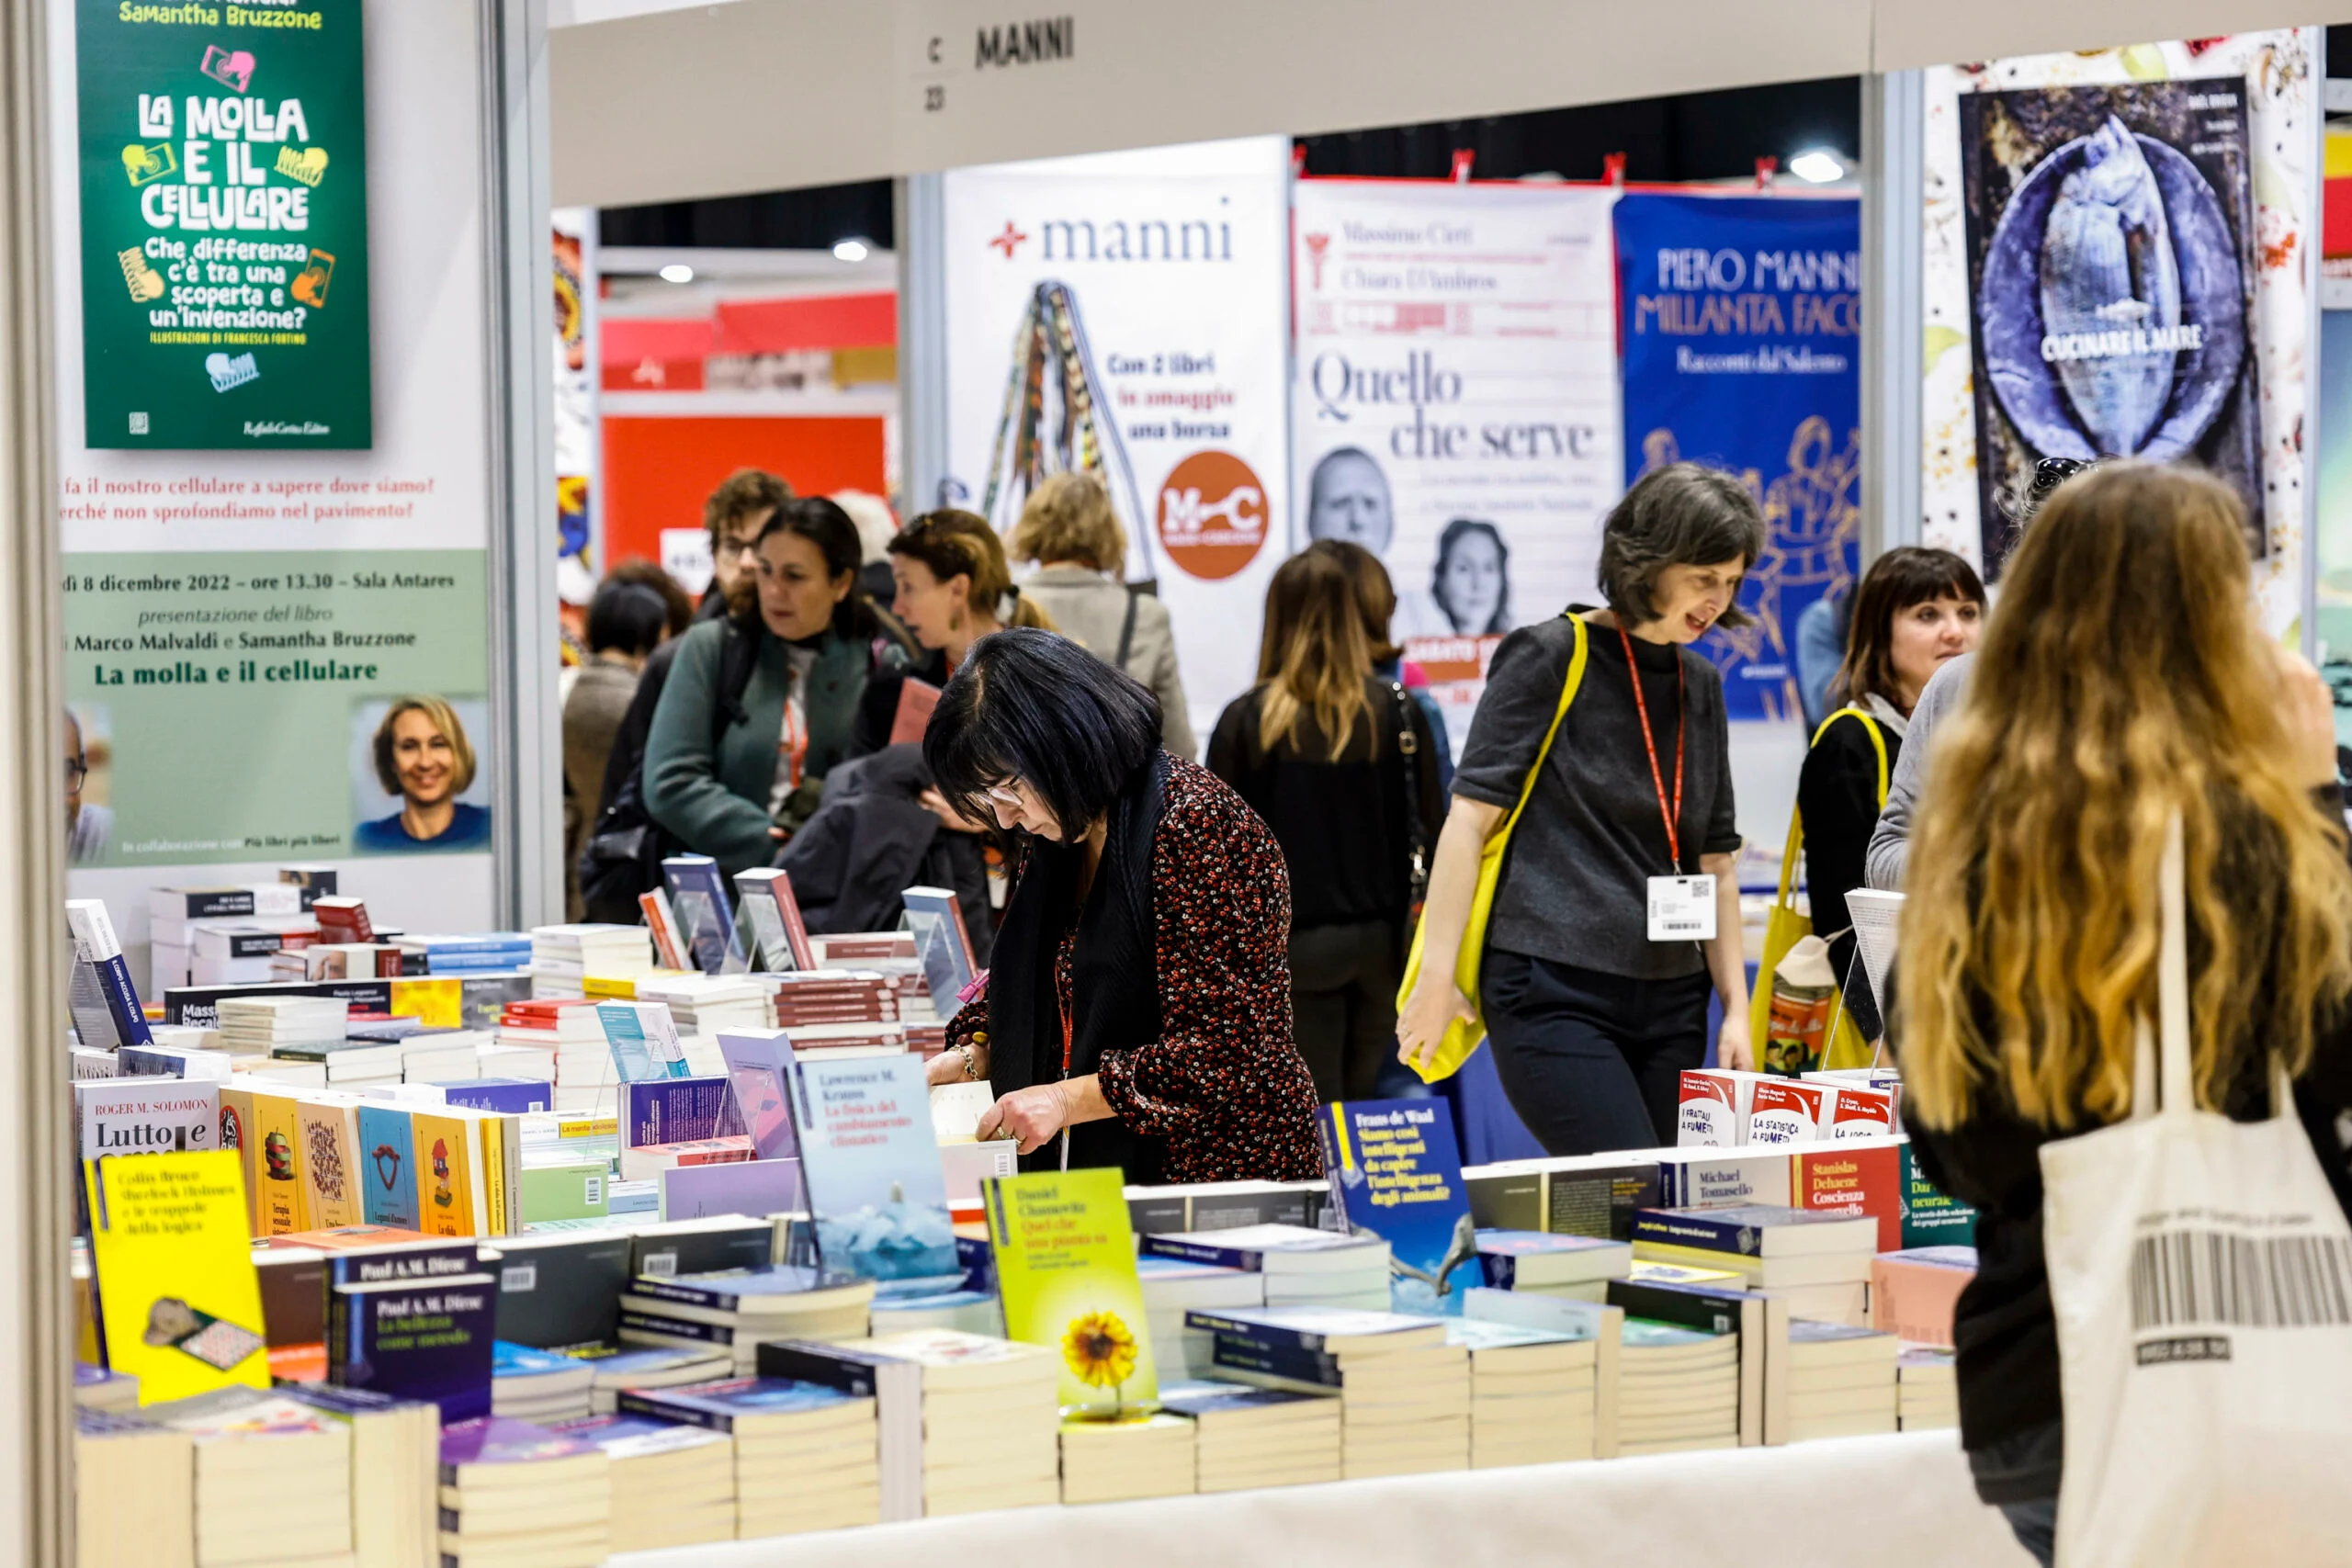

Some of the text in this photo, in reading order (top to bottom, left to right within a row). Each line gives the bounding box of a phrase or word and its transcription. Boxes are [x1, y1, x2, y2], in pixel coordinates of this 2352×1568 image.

[119, 1, 322, 29] Samantha Bruzzone
[928, 36, 943, 64] C
[974, 17, 1074, 70] MANNI
[138, 94, 310, 142] LA MOLLA
[185, 141, 266, 186] E IL
[141, 185, 309, 231] CELLULARE
[1041, 196, 1233, 263] manni
[145, 236, 308, 263] Che differenza
[168, 256, 287, 285] c'è tra una
[1657, 247, 1747, 292] PIERO
[171, 283, 285, 310] scoperta e
[149, 304, 307, 330] un'invenzione?
[1634, 292, 1786, 336] MILLANTA
[150, 331, 211, 344] ILLUSTRAZIONI
[212, 332, 222, 344] DI
[224, 332, 270, 345] FRANCESCA
[2041, 322, 2202, 362] CUCINARE IL MARE
[1107, 354, 1148, 375] Con
[1169, 352, 1216, 375] libri
[1312, 347, 1463, 422] Quello
[1144, 387, 1235, 411] omaggio
[1128, 419, 1231, 440] una borsa
[1390, 405, 1595, 459] che serve
[65, 477, 81, 495] fa
[87, 477, 99, 495] il
[105, 479, 163, 495] nostro
[168, 477, 246, 495] cellulare
[251, 481, 262, 494] a
[267, 480, 324, 498] sapere
[329, 477, 373, 494] dove
[59, 502, 107, 521] erché
[113, 506, 147, 520] non
[153, 502, 276, 524] sprofondiamo
[281, 502, 309, 519] nel
[62, 570, 455, 592] dì 8 dicembre 2022 ore 13.30 Sala Antares
[138, 604, 334, 628] presentazione del libro
[74, 629, 417, 651] Marco Malvaldi e Samantha Bruzzone
[94, 659, 379, 686] La molla e il cellulare
[135, 837, 220, 853] collaborazione
[265, 835, 288, 848] libri
[114, 964, 123, 981] CORPO
[119, 978, 131, 1002] ACCUSA
[96, 1099, 209, 1116] ROGER M. SOLOMON
[1389, 1110, 1405, 1125] de
[96, 1122, 207, 1147] Lutto e
[571, 1124, 591, 1133] mente
[1754, 1118, 1799, 1135] LA STATISTICA
[1836, 1128, 1846, 1138] LA
[1699, 1168, 1740, 1184] Michael
[1813, 1160, 1859, 1176] Stanislas
[1699, 1183, 1754, 1200] Tomasello
[1813, 1177, 1860, 1190] Dehaene
[273, 1202, 290, 1216] Terapia
[1813, 1190, 1865, 1205] Coscienza
[360, 1261, 392, 1281] Paul
[377, 1298, 410, 1318] Paul
